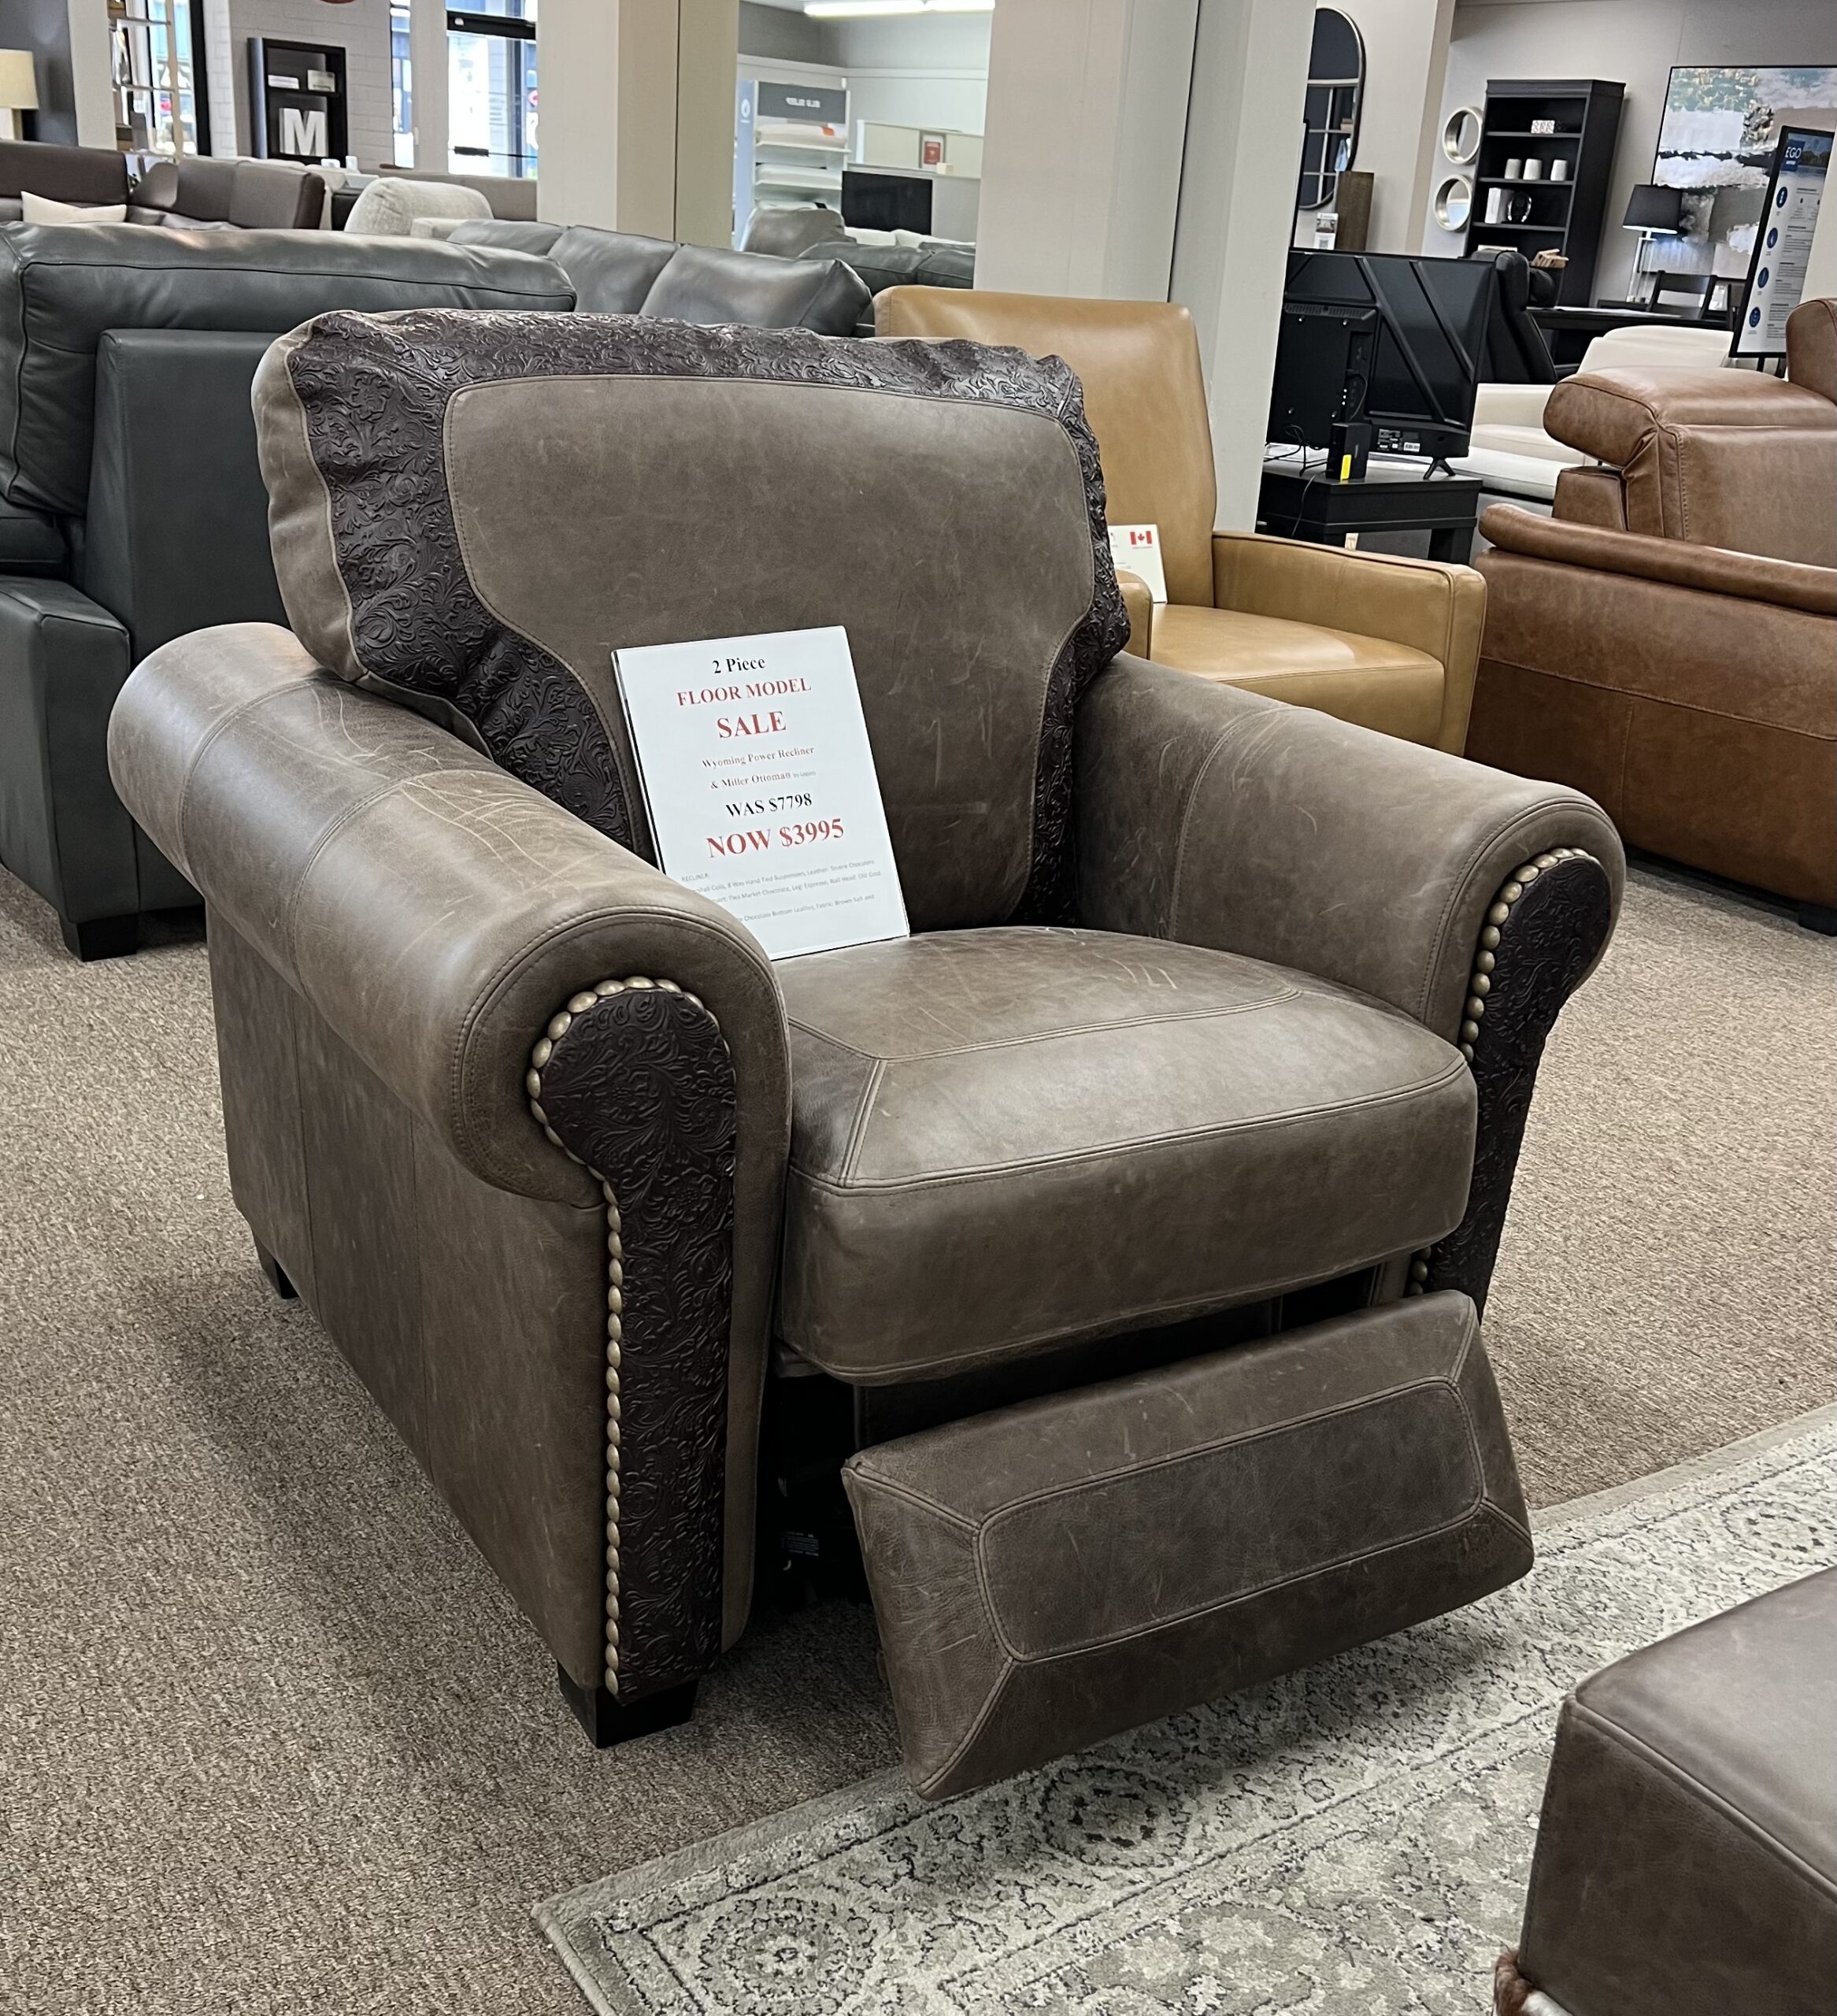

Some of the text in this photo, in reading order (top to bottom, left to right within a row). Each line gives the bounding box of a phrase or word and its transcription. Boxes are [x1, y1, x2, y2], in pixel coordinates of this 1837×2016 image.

[279, 107, 328, 158] M
[1785, 146, 1802, 158] EGO
[713, 658, 766, 674] 2 Piece
[676, 678, 812, 706] FLOOR MODEL
[717, 710, 786, 739] SALE
[702, 747, 814, 769] Wyoming Power Recliner
[710, 780, 718, 789] &
[721, 776, 749, 788] Miller
[751, 771, 791, 784] Ottoman
[725, 792, 813, 817] WAS $7798
[706, 817, 844, 858] NOW $3995
